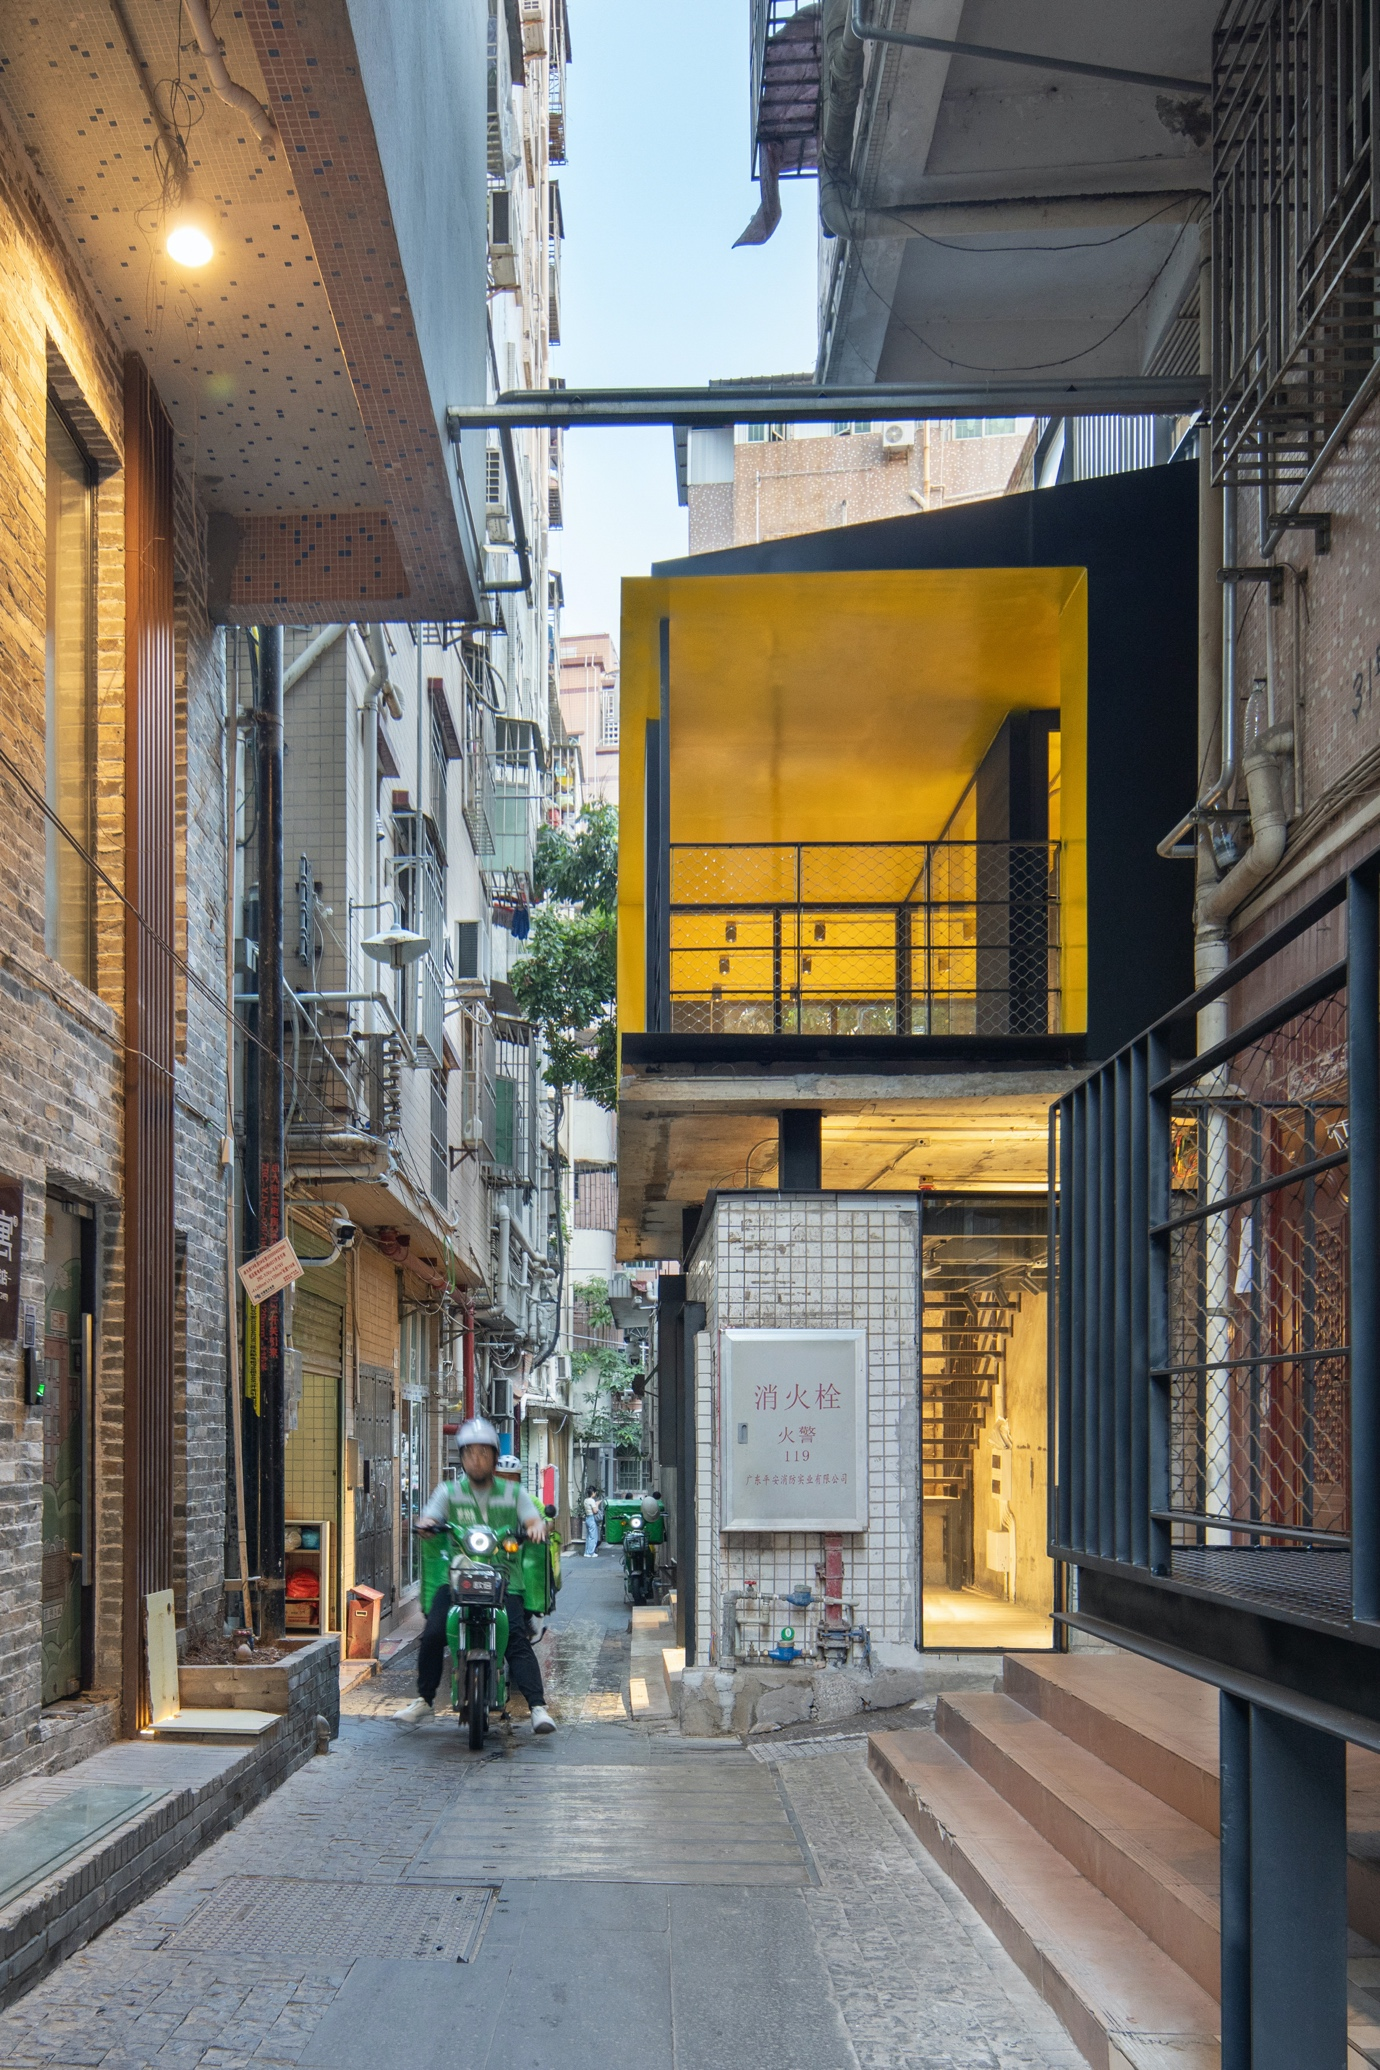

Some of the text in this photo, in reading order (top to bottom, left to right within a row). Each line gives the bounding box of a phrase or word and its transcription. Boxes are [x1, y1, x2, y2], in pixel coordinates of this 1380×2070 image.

[754, 1382, 842, 1411] 消火栓
[777, 1425, 817, 1445] 火警
[785, 1450, 810, 1462] 119
[745, 1473, 848, 1486] 广东平安消防实业有限公司
